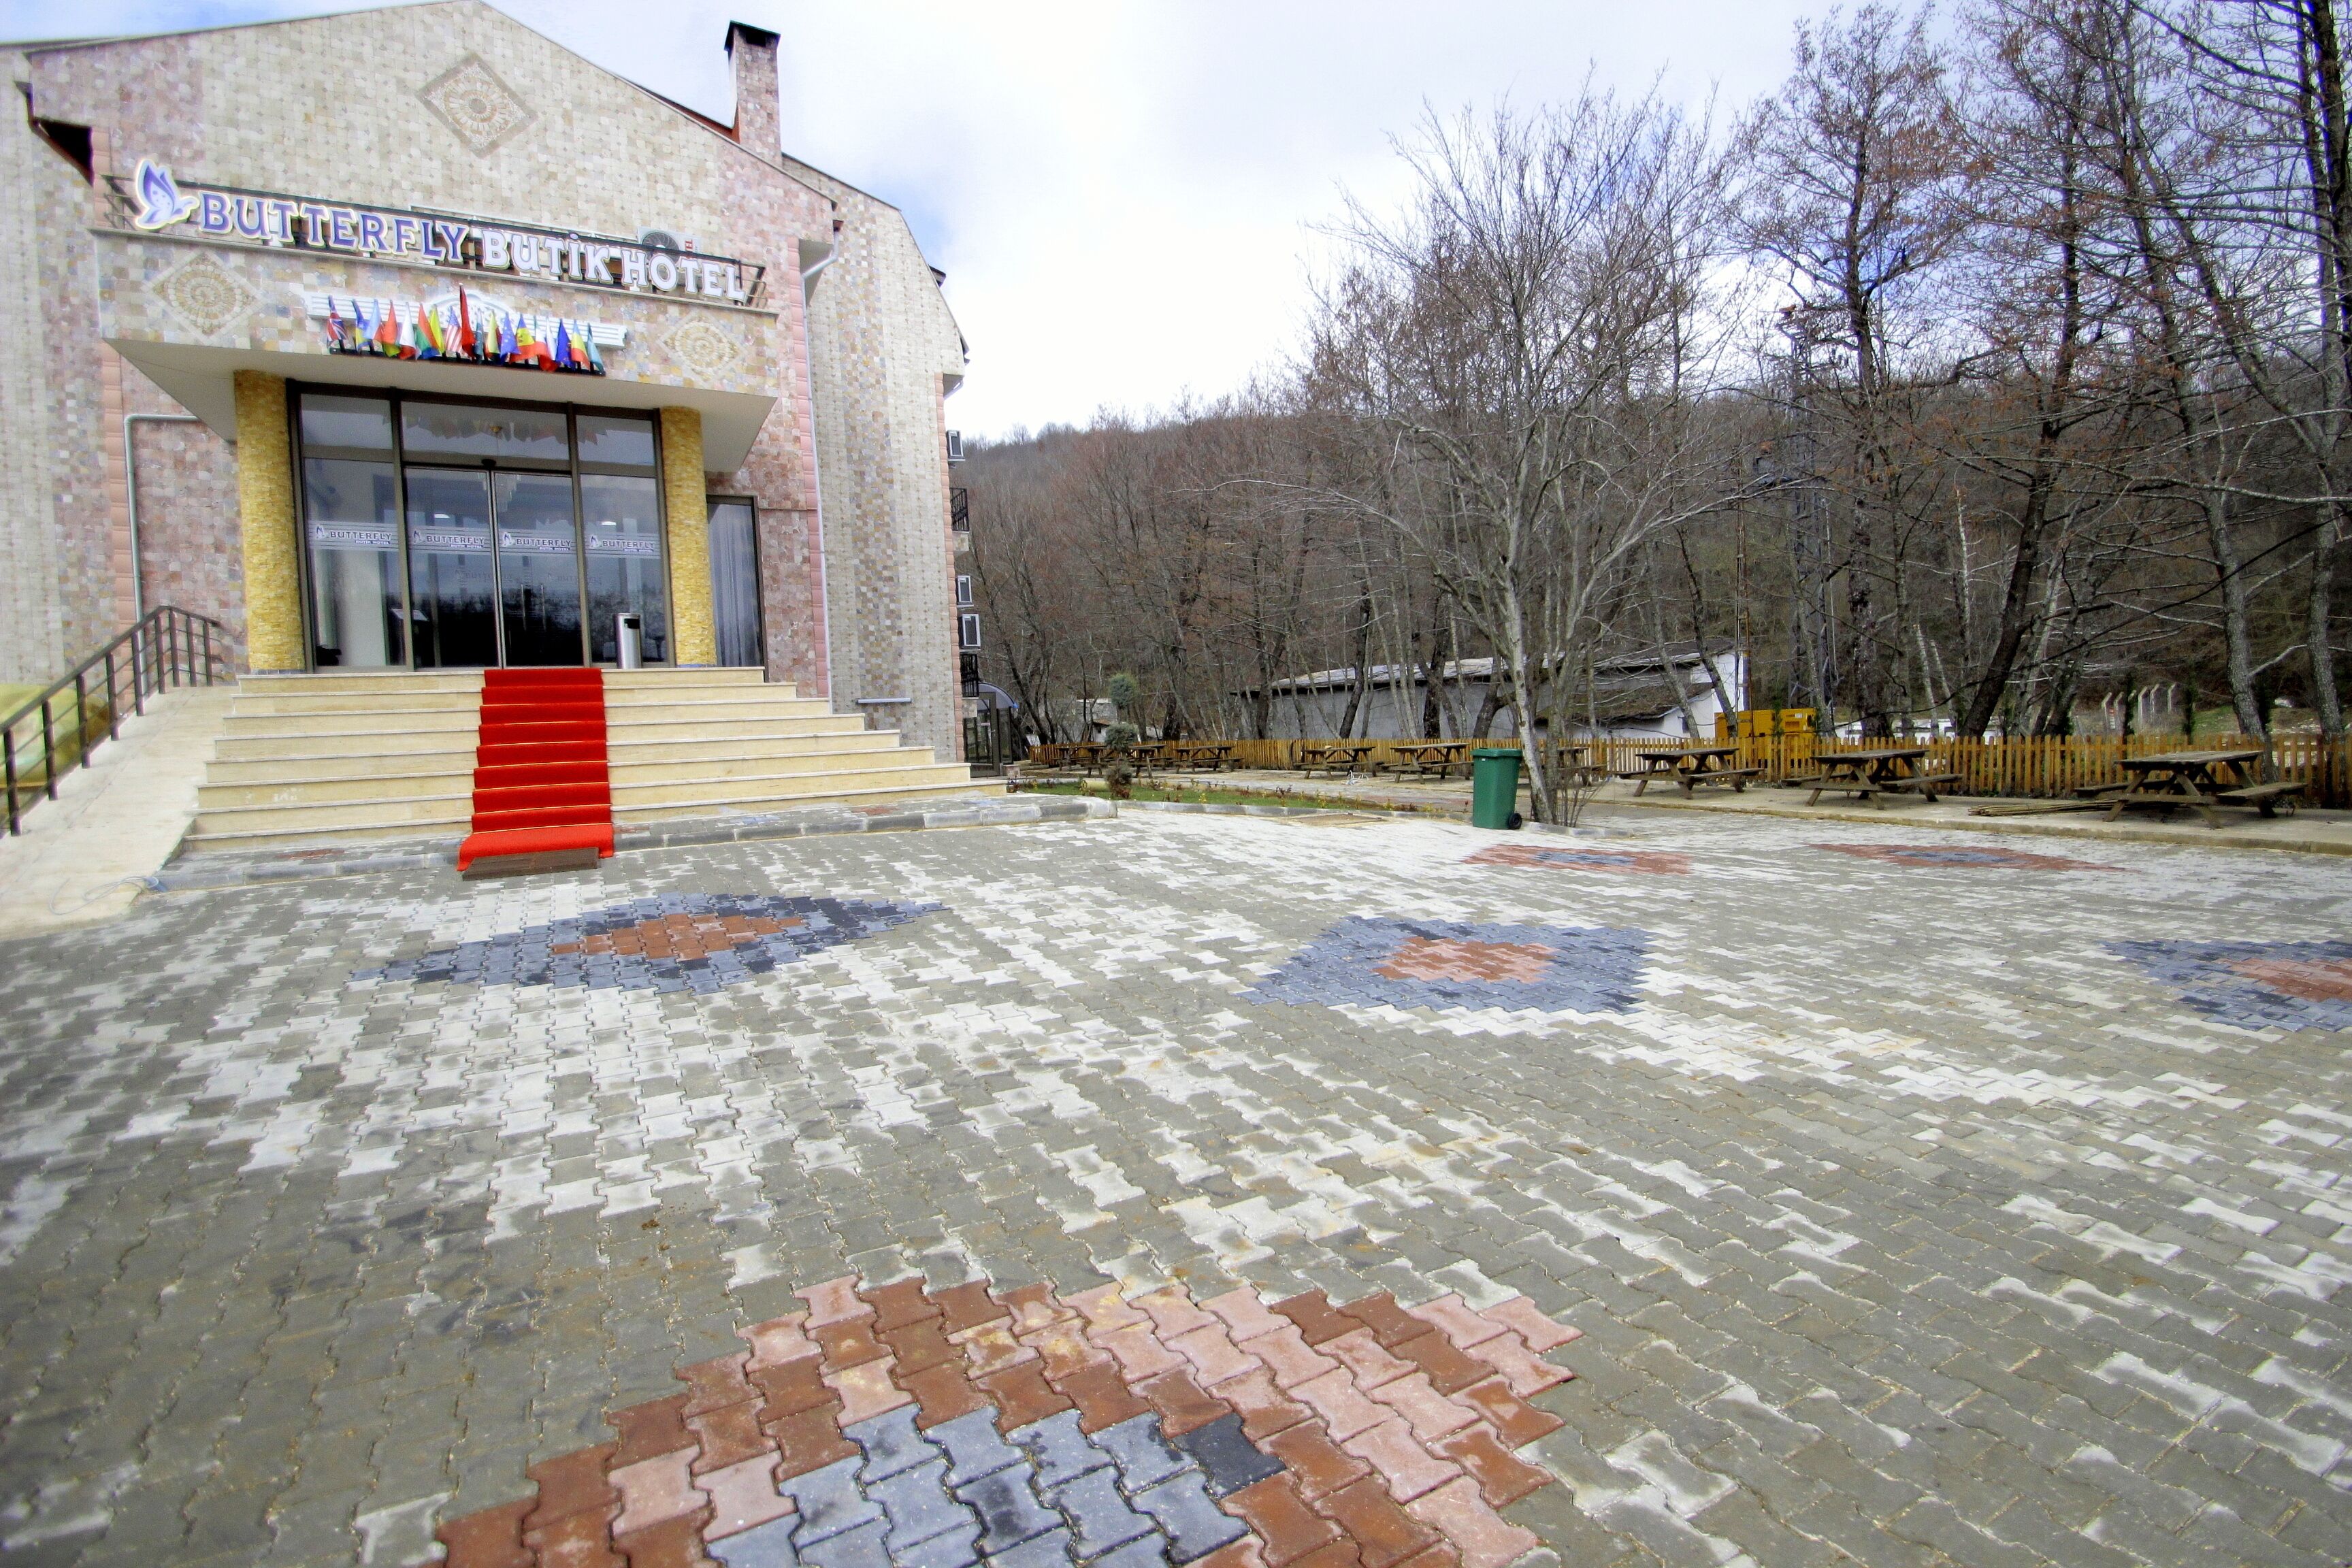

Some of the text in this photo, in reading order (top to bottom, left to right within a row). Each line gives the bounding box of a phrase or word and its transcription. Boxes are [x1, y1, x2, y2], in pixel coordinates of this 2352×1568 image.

[199, 191, 470, 264] BUTTERFLY
[621, 249, 747, 302] HOTEL
[330, 531, 392, 540] BUTTERFLY
[427, 536, 485, 544] BUTTERFLY
[516, 538, 571, 546] BUTTERFLY
[602, 540, 653, 549] BUTTERFLY
